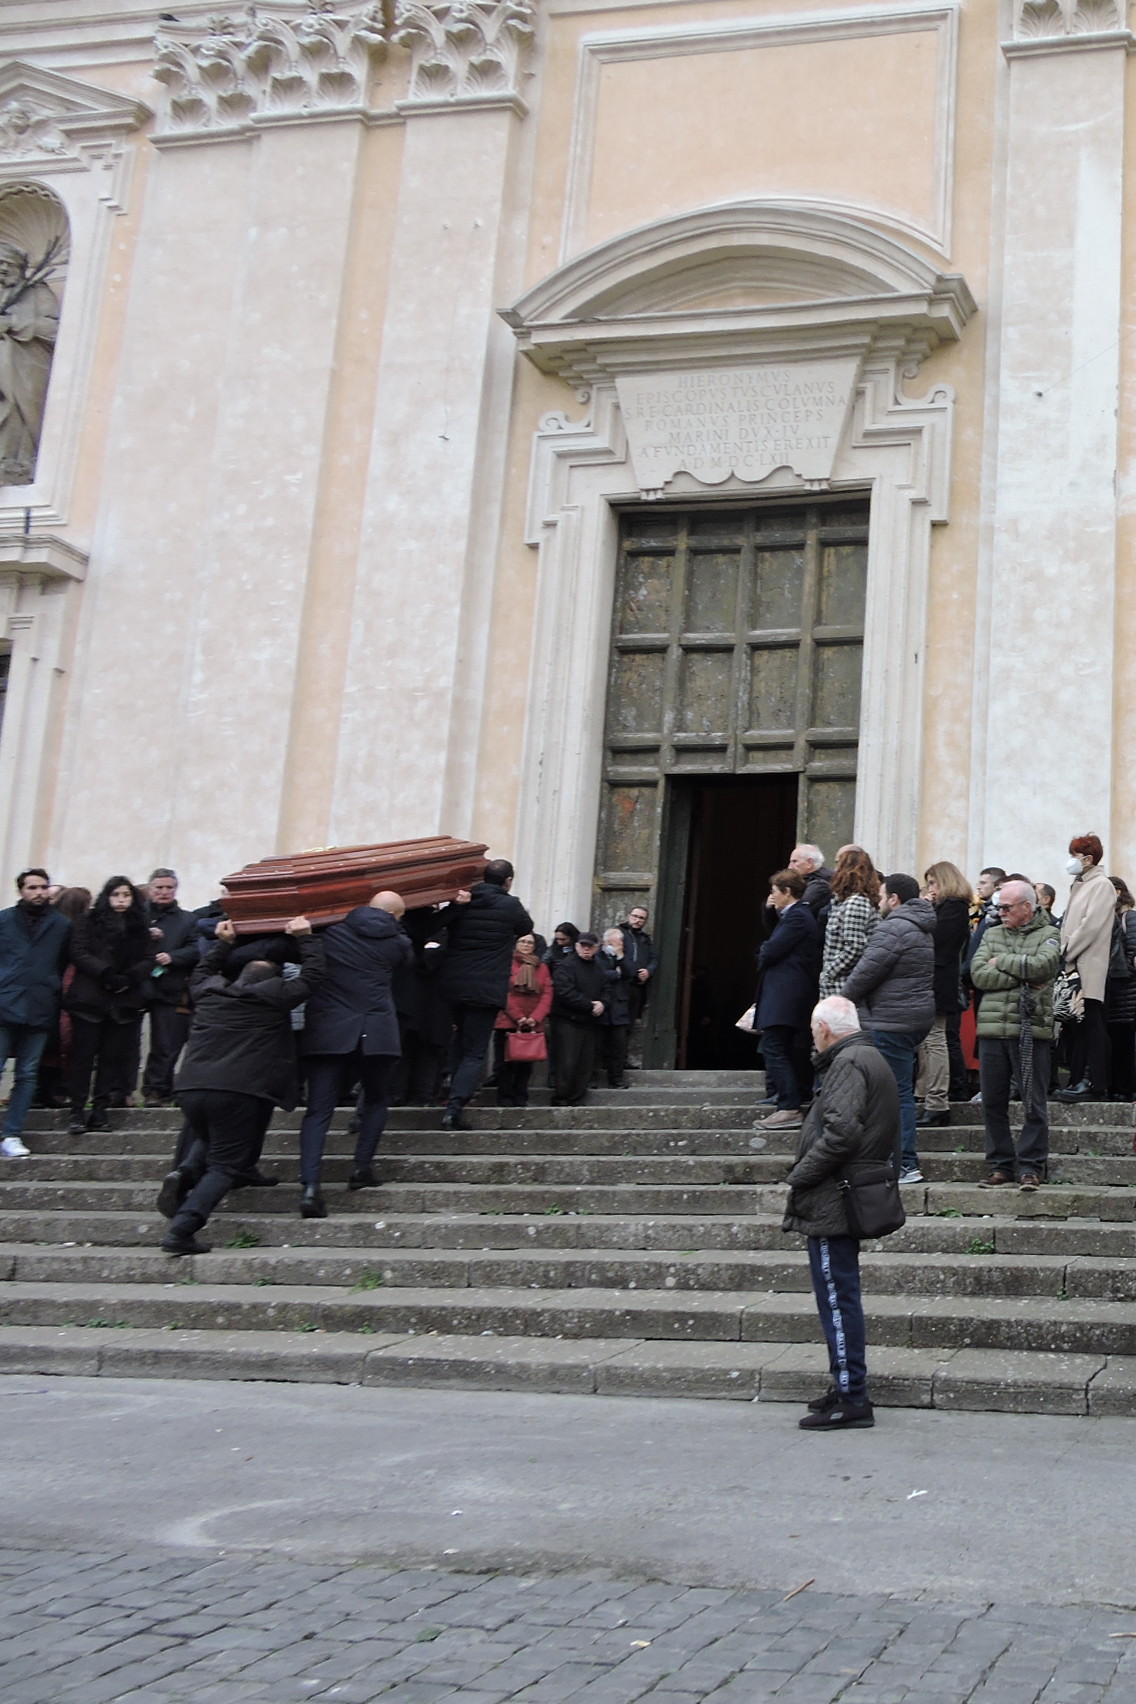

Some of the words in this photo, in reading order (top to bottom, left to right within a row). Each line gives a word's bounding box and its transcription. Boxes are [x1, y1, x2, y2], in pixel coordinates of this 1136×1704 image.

[678, 370, 791, 389] HIERONYMVS
[636, 387, 727, 406] EPISCOPVS
[730, 380, 834, 399] TVSCVLANVS
[662, 399, 760, 418] CARDINALIS
[764, 394, 846, 412] COLVMNA
[644, 415, 729, 432] ROMANVS
[738, 408, 823, 425] PRINCEPS
[668, 428, 729, 445] MARINI
[774, 436, 831, 451] EREXIT
